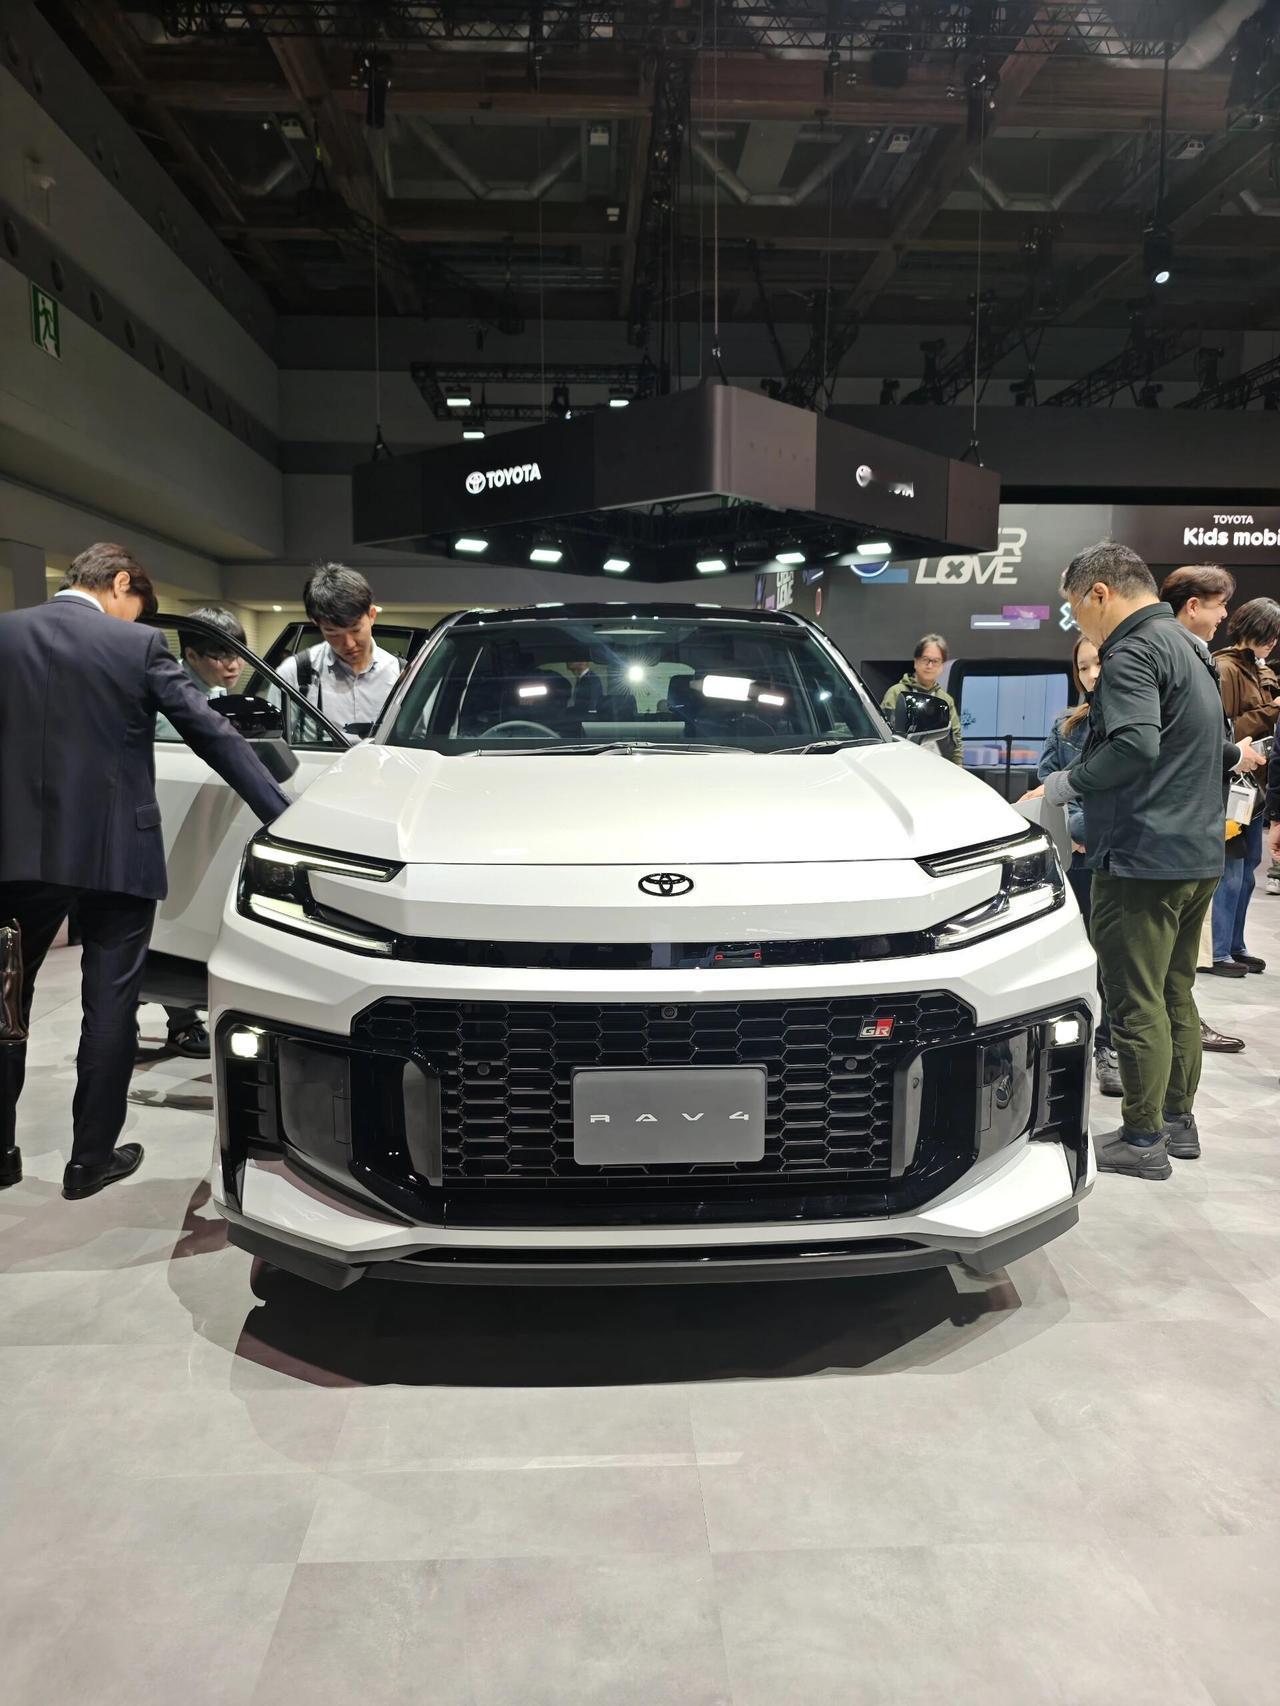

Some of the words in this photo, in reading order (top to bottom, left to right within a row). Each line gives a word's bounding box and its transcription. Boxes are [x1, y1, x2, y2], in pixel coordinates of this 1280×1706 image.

[486, 463, 541, 488] TOYOTA
[1213, 515, 1254, 524] TOYOTA
[1184, 527, 1229, 545] Kids
[915, 556, 1022, 585] LOVE
[862, 1026, 890, 1036] GR
[590, 1111, 749, 1123] RAV4
